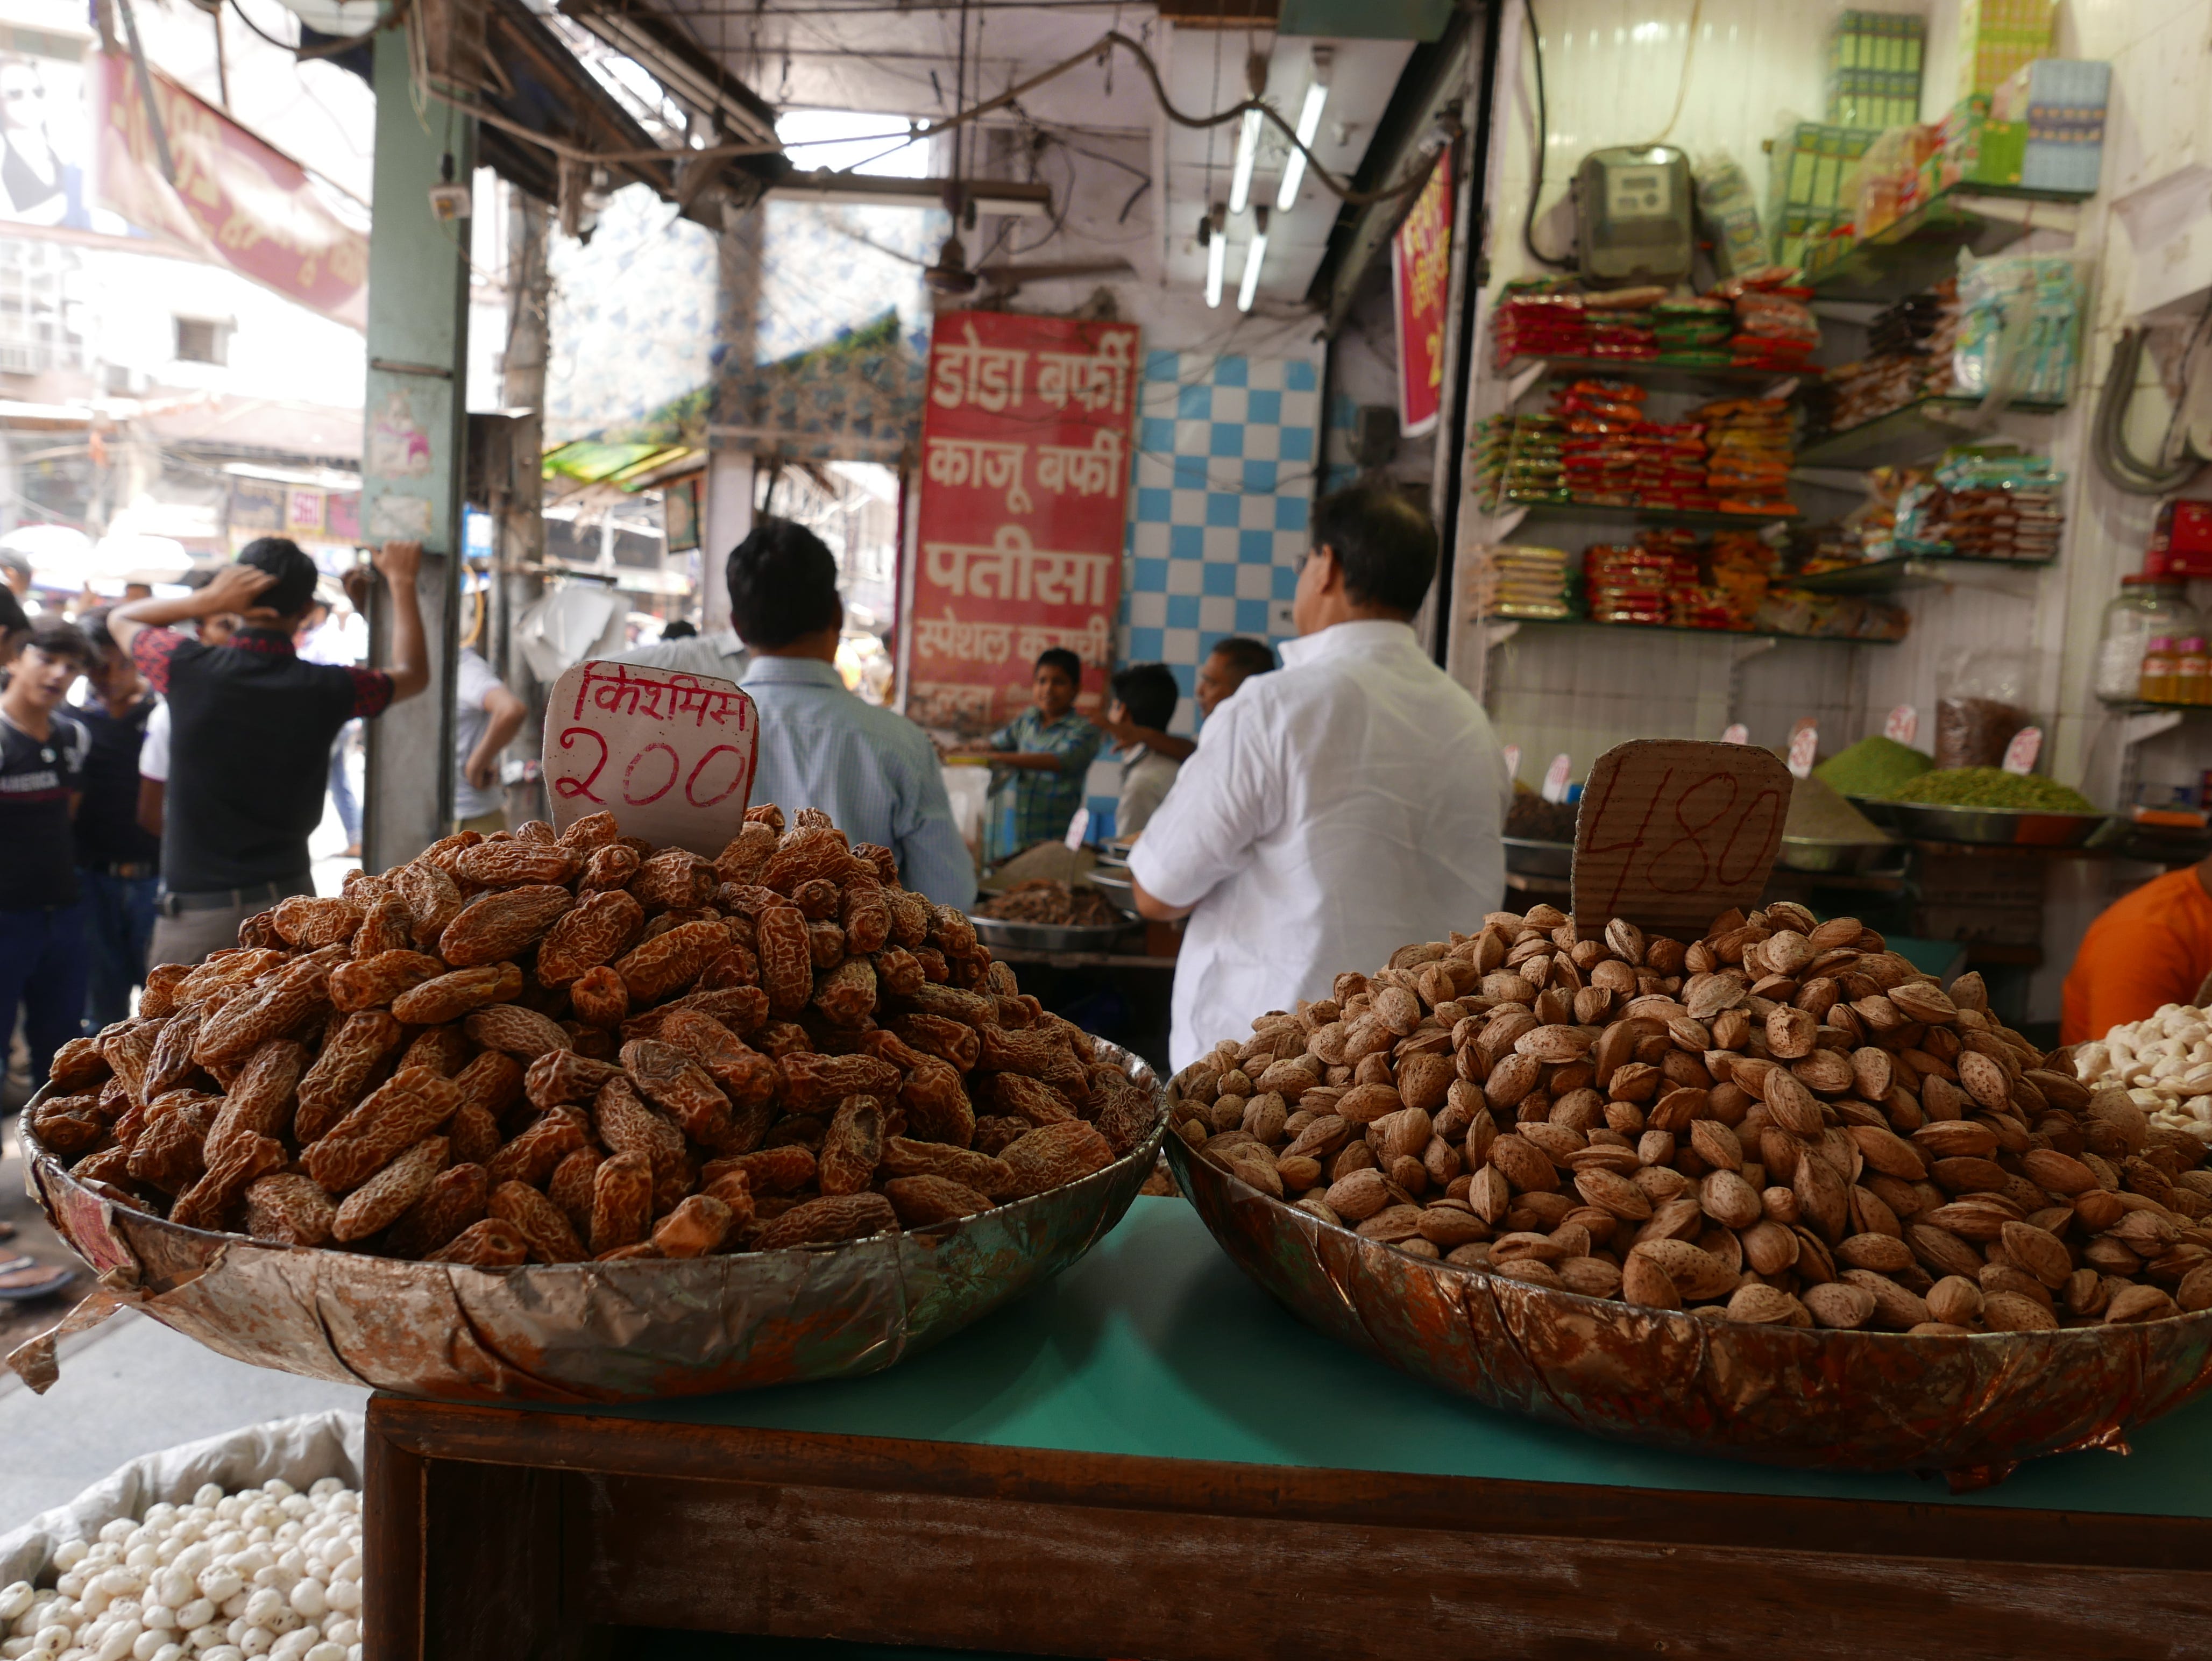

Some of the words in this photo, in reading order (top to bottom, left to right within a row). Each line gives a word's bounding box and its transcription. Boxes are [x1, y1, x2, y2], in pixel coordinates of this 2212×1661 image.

[932, 321, 1029, 412] डोडा
[1037, 331, 1134, 415] बर्फी
[927, 437, 1034, 515] काजू
[923, 523, 1114, 606] पतीसा
[1585, 755, 1779, 913] 480
